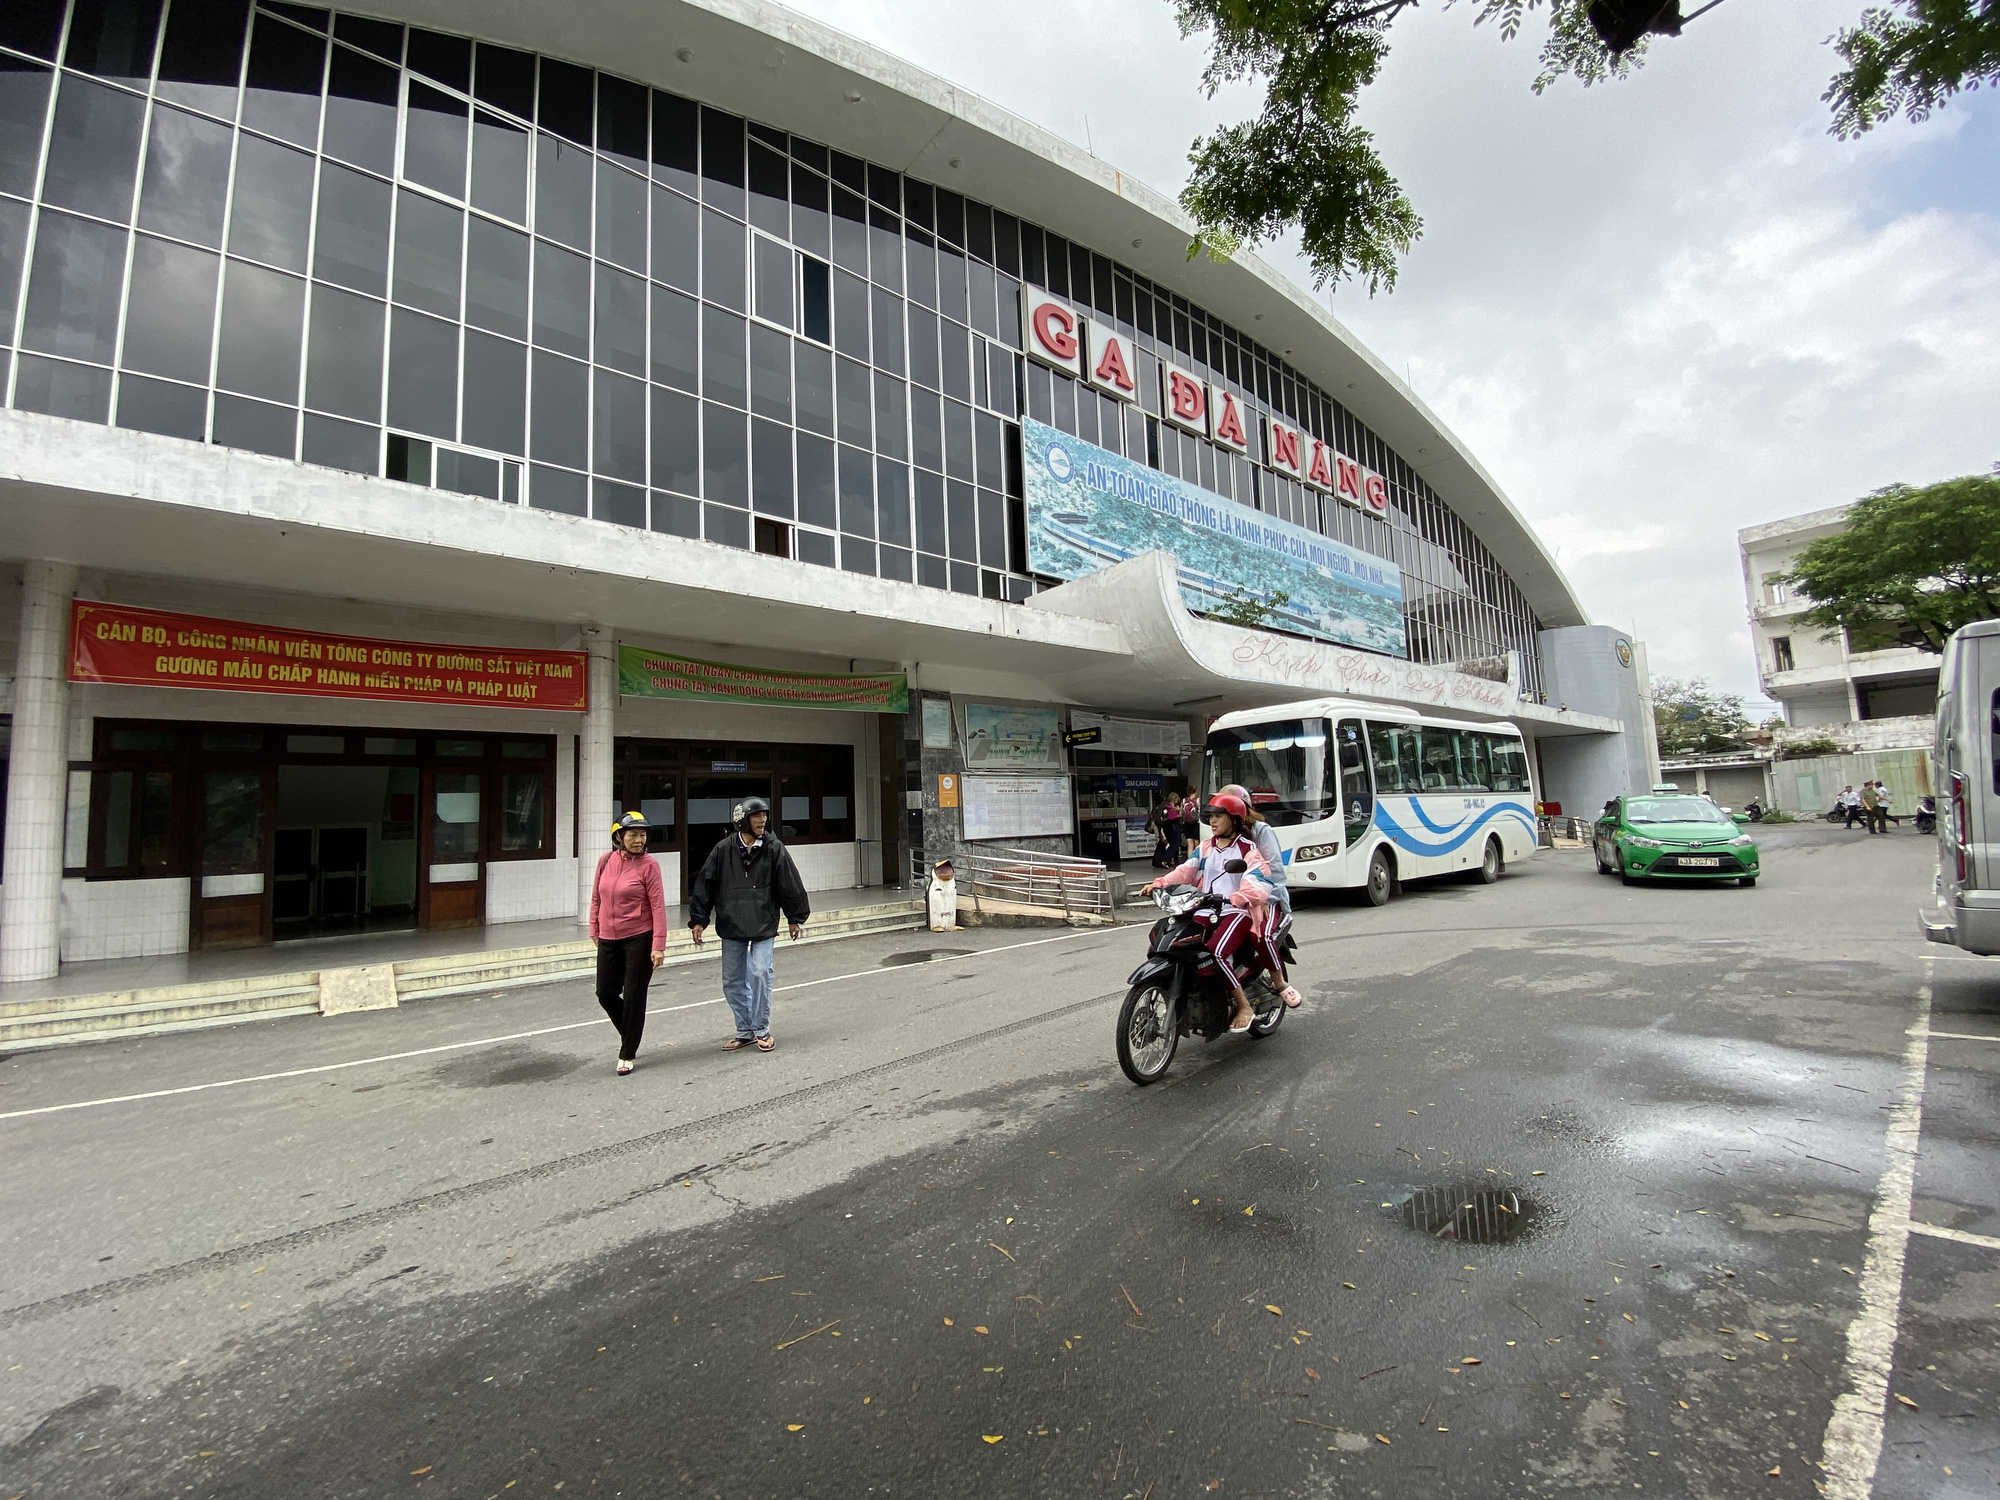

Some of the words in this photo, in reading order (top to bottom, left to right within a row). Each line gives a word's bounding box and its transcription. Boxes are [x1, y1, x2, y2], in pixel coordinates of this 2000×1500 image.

[1033, 302, 1134, 392] GA
[1170, 370, 1248, 446] ĐÀ
[1273, 422, 1388, 510] NẴNG
[1087, 462, 1107, 492] AN
[1110, 470, 1146, 506] TOÀN
[1148, 484, 1177, 516] GIAO
[1180, 496, 1217, 530] THÔNG
[1219, 509, 1233, 536] LÀ
[1234, 516, 1261, 546] HẠNH
[1263, 528, 1289, 554] PHÚC
[1290, 534, 1308, 560] CỦA
[1310, 544, 1326, 568] MỌI
[1354, 560, 1369, 585] MỌI
[1370, 565, 1385, 588] NHÀ
[97, 620, 136, 642] CÁN
[142, 625, 172, 648] BỘ,
[178, 629, 226, 650] CÔNG
[232, 636, 280, 655] NHÂN
[285, 640, 322, 660] VIÊN
[327, 642, 367, 664] TỔNG
[372, 647, 412, 667] CÔNG
[417, 653, 433, 668] TY
[437, 653, 483, 673] ĐƯỜNG
[487, 656, 511, 675] SẮT
[516, 660, 541, 679] VIỆT
[545, 663, 573, 679] NAM
[644, 659, 681, 673] CHUNG
[684, 663, 700, 675] TAY
[156, 656, 218, 677] GƯƠNG
[223, 657, 263, 680] MẪU
[268, 662, 312, 682] CHẤP
[317, 667, 360, 686] HÀNH
[365, 671, 400, 689] HIẾN
[404, 675, 442, 691] PHÁP
[446, 677, 463, 693] VÀ
[468, 680, 503, 698] PHÁP
[507, 682, 537, 702] LUẬT
[652, 676, 689, 690] CHUNG
[691, 680, 707, 692] TAY
[800, 691, 823, 702] XANH
[824, 692, 852, 703] KHÔNG
[1097, 832, 1112, 844] 4G
